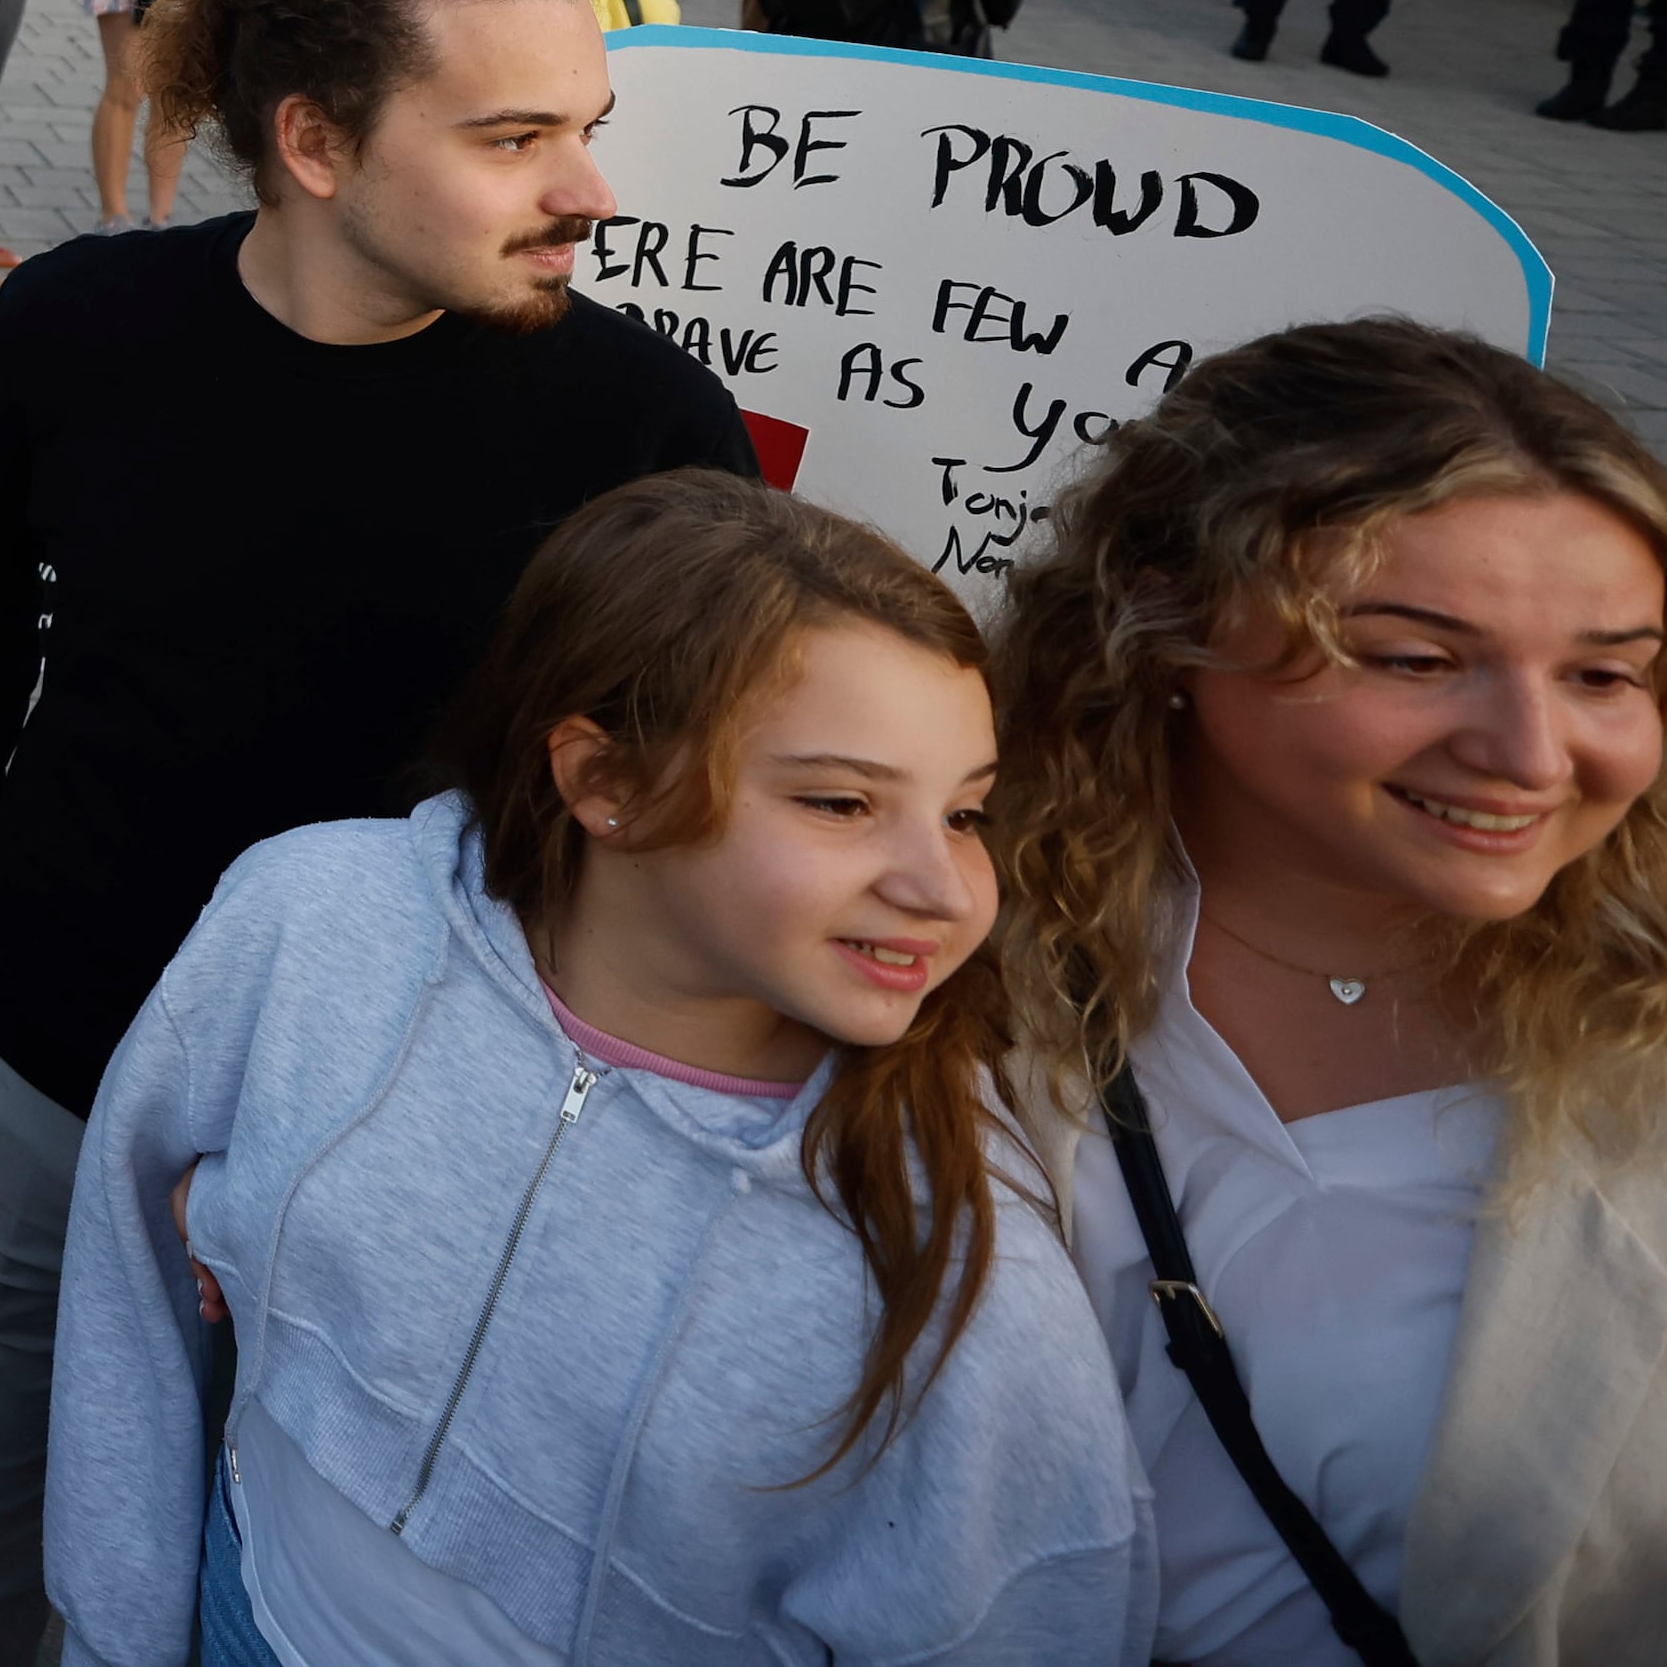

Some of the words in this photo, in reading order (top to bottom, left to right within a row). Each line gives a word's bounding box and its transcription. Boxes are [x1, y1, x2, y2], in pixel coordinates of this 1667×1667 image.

[720, 104, 863, 190] BE
[920, 123, 1260, 239] PROUD
[763, 240, 883, 317] ARE
[932, 279, 1071, 355] FEW
[836, 342, 926, 409] AS
